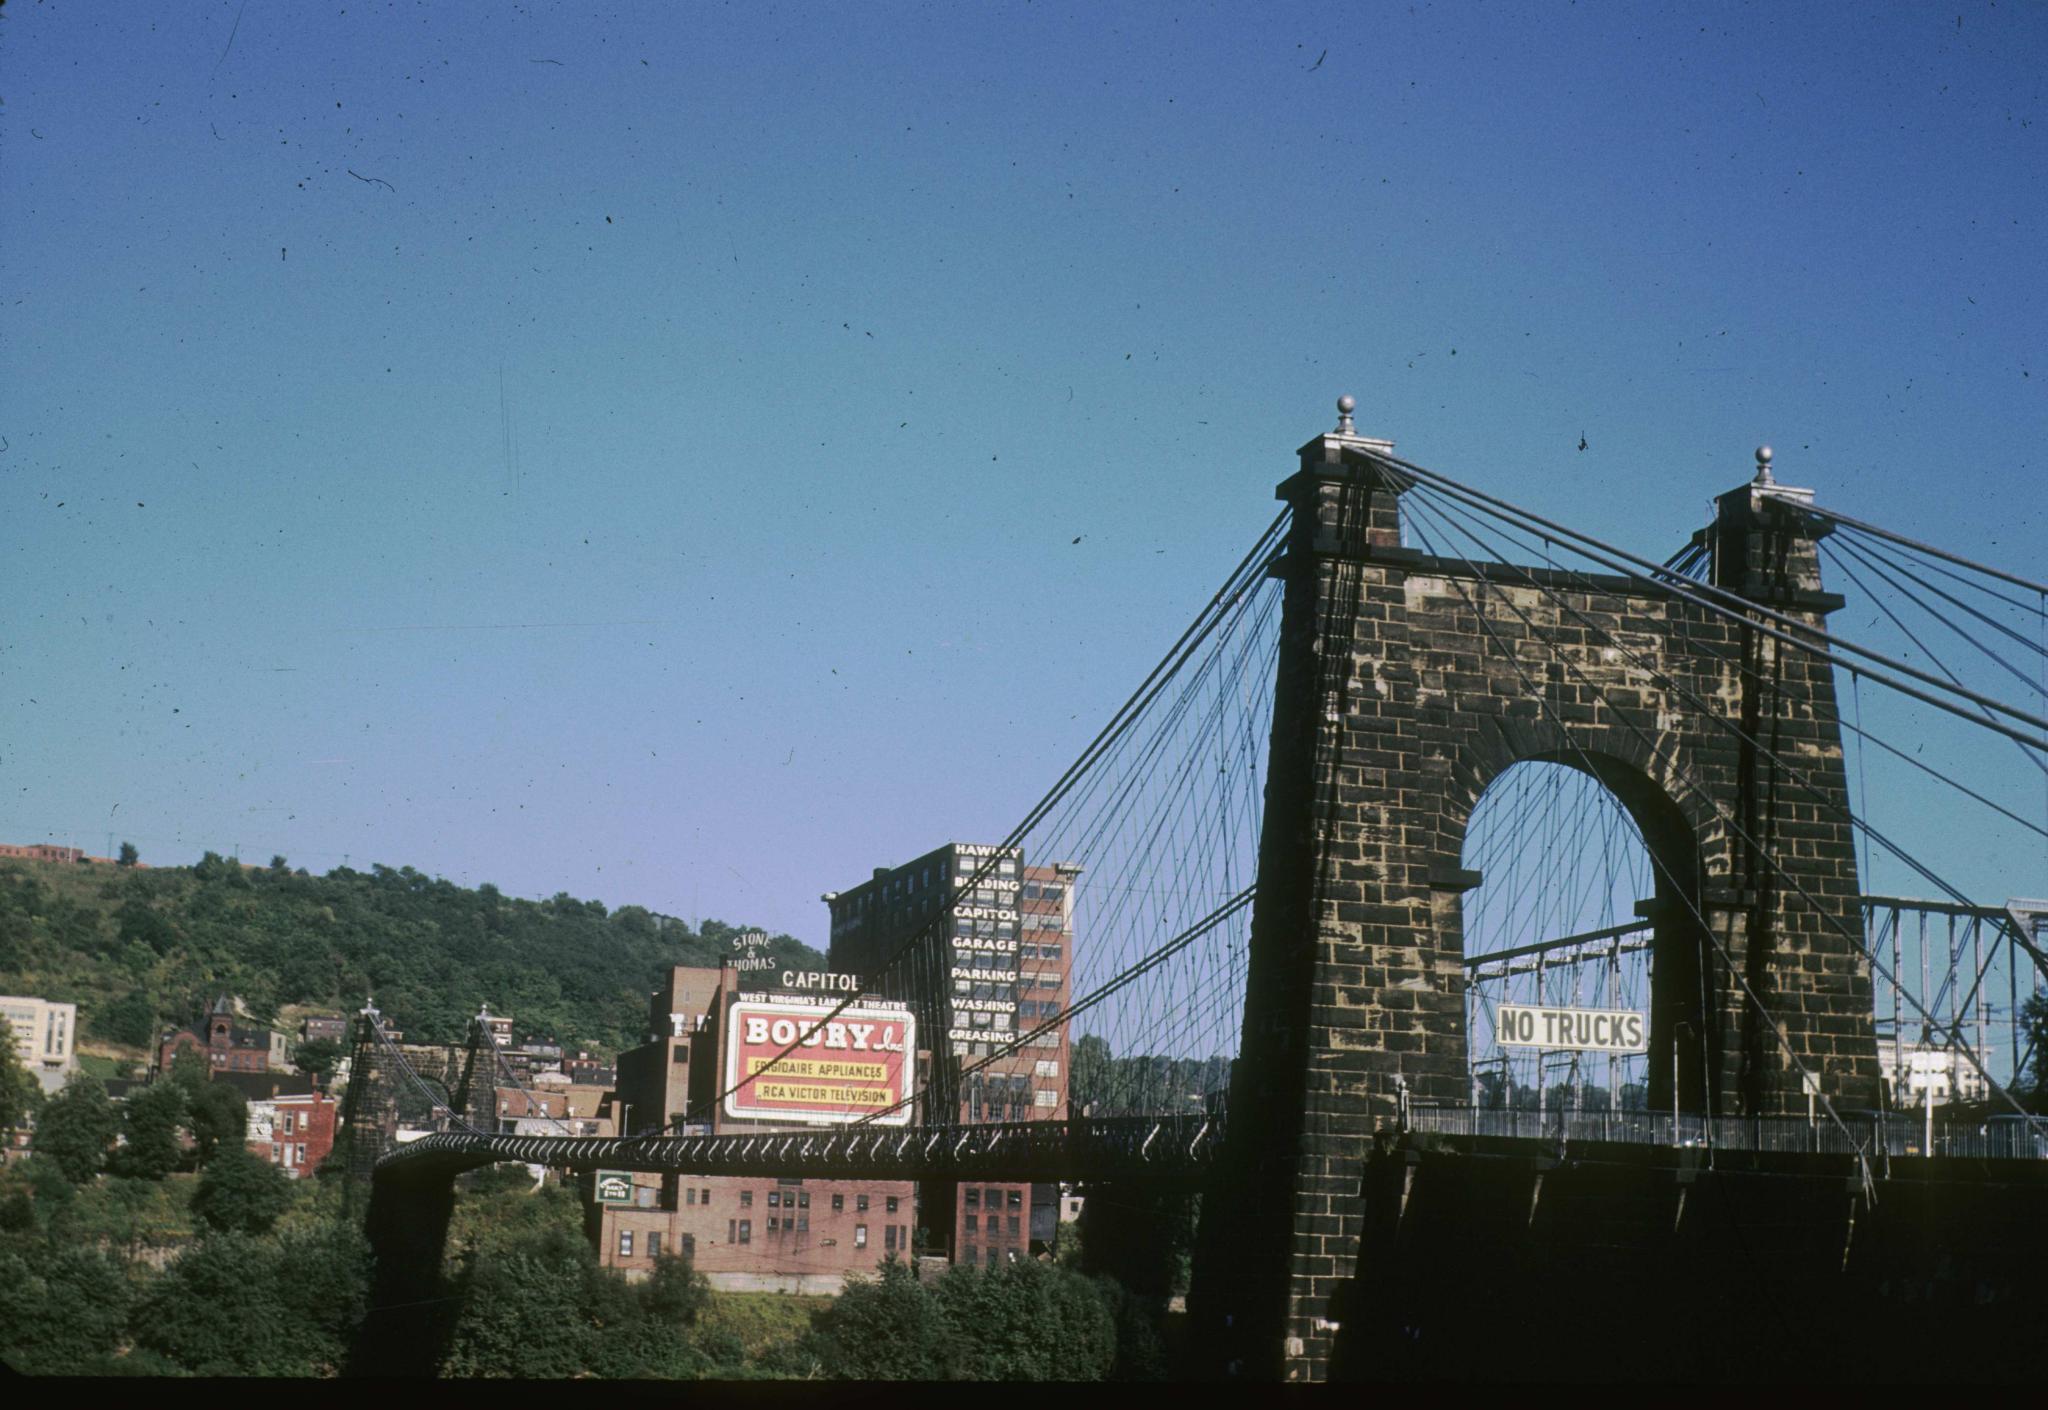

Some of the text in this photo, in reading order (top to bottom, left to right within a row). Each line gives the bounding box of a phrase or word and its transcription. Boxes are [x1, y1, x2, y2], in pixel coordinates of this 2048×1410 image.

[953, 906, 1020, 921] CAPITOL
[733, 933, 772, 952] STONE
[952, 937, 1018, 951] GARAGE
[747, 946, 757, 958] &
[782, 970, 859, 992] CAPITOL
[951, 967, 1017, 982] PARKING
[739, 992, 768, 1004] WEST
[769, 994, 816, 1007] VIRGINIA'S
[863, 1000, 907, 1012] THEATRE
[950, 998, 1017, 1012] WASHING
[745, 1017, 875, 1050] BOURY
[1501, 1010, 1642, 1047] NO TRUCKS
[948, 1029, 1016, 1044] GREASING
[818, 1064, 882, 1078] APPLIANCES
[763, 1085, 886, 1103] RCA VICTOR TELEVISION
